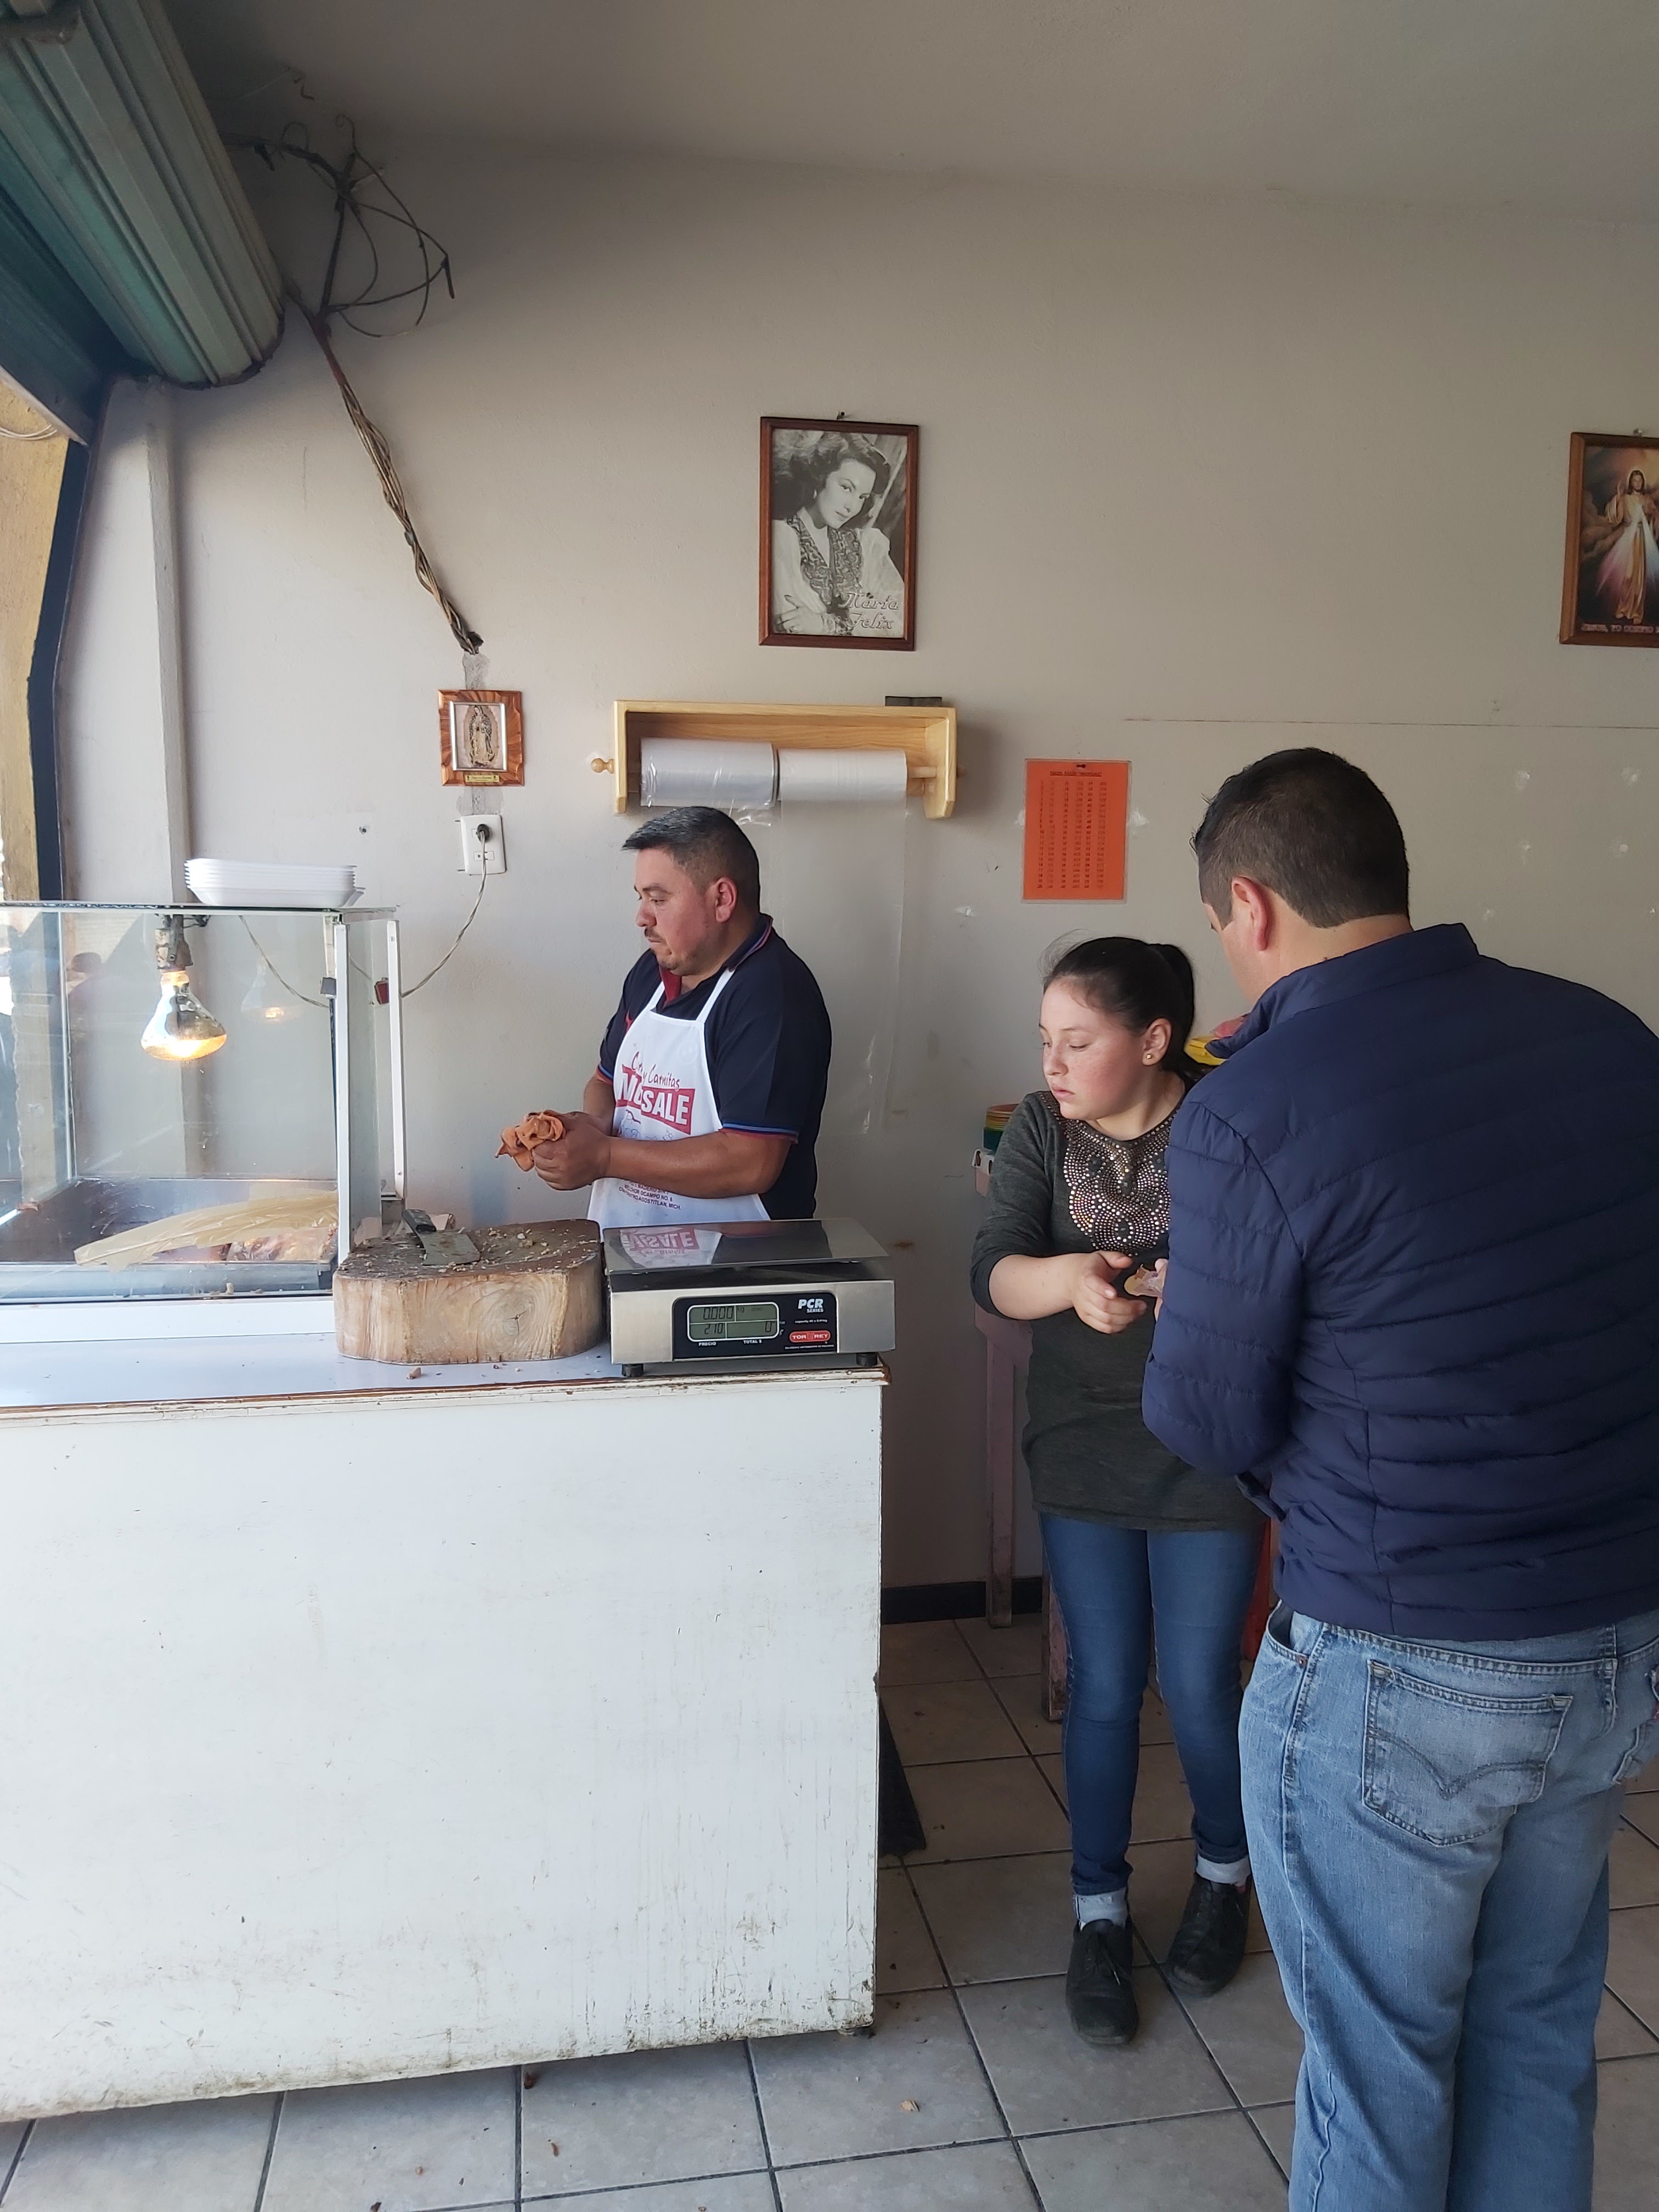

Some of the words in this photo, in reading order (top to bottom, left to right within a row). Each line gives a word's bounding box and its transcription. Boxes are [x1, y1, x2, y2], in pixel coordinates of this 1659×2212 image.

[648, 1064, 680, 1090] Carnitas
[798, 1299, 823, 1309] PCR
[704, 1323, 724, 1335] 210
